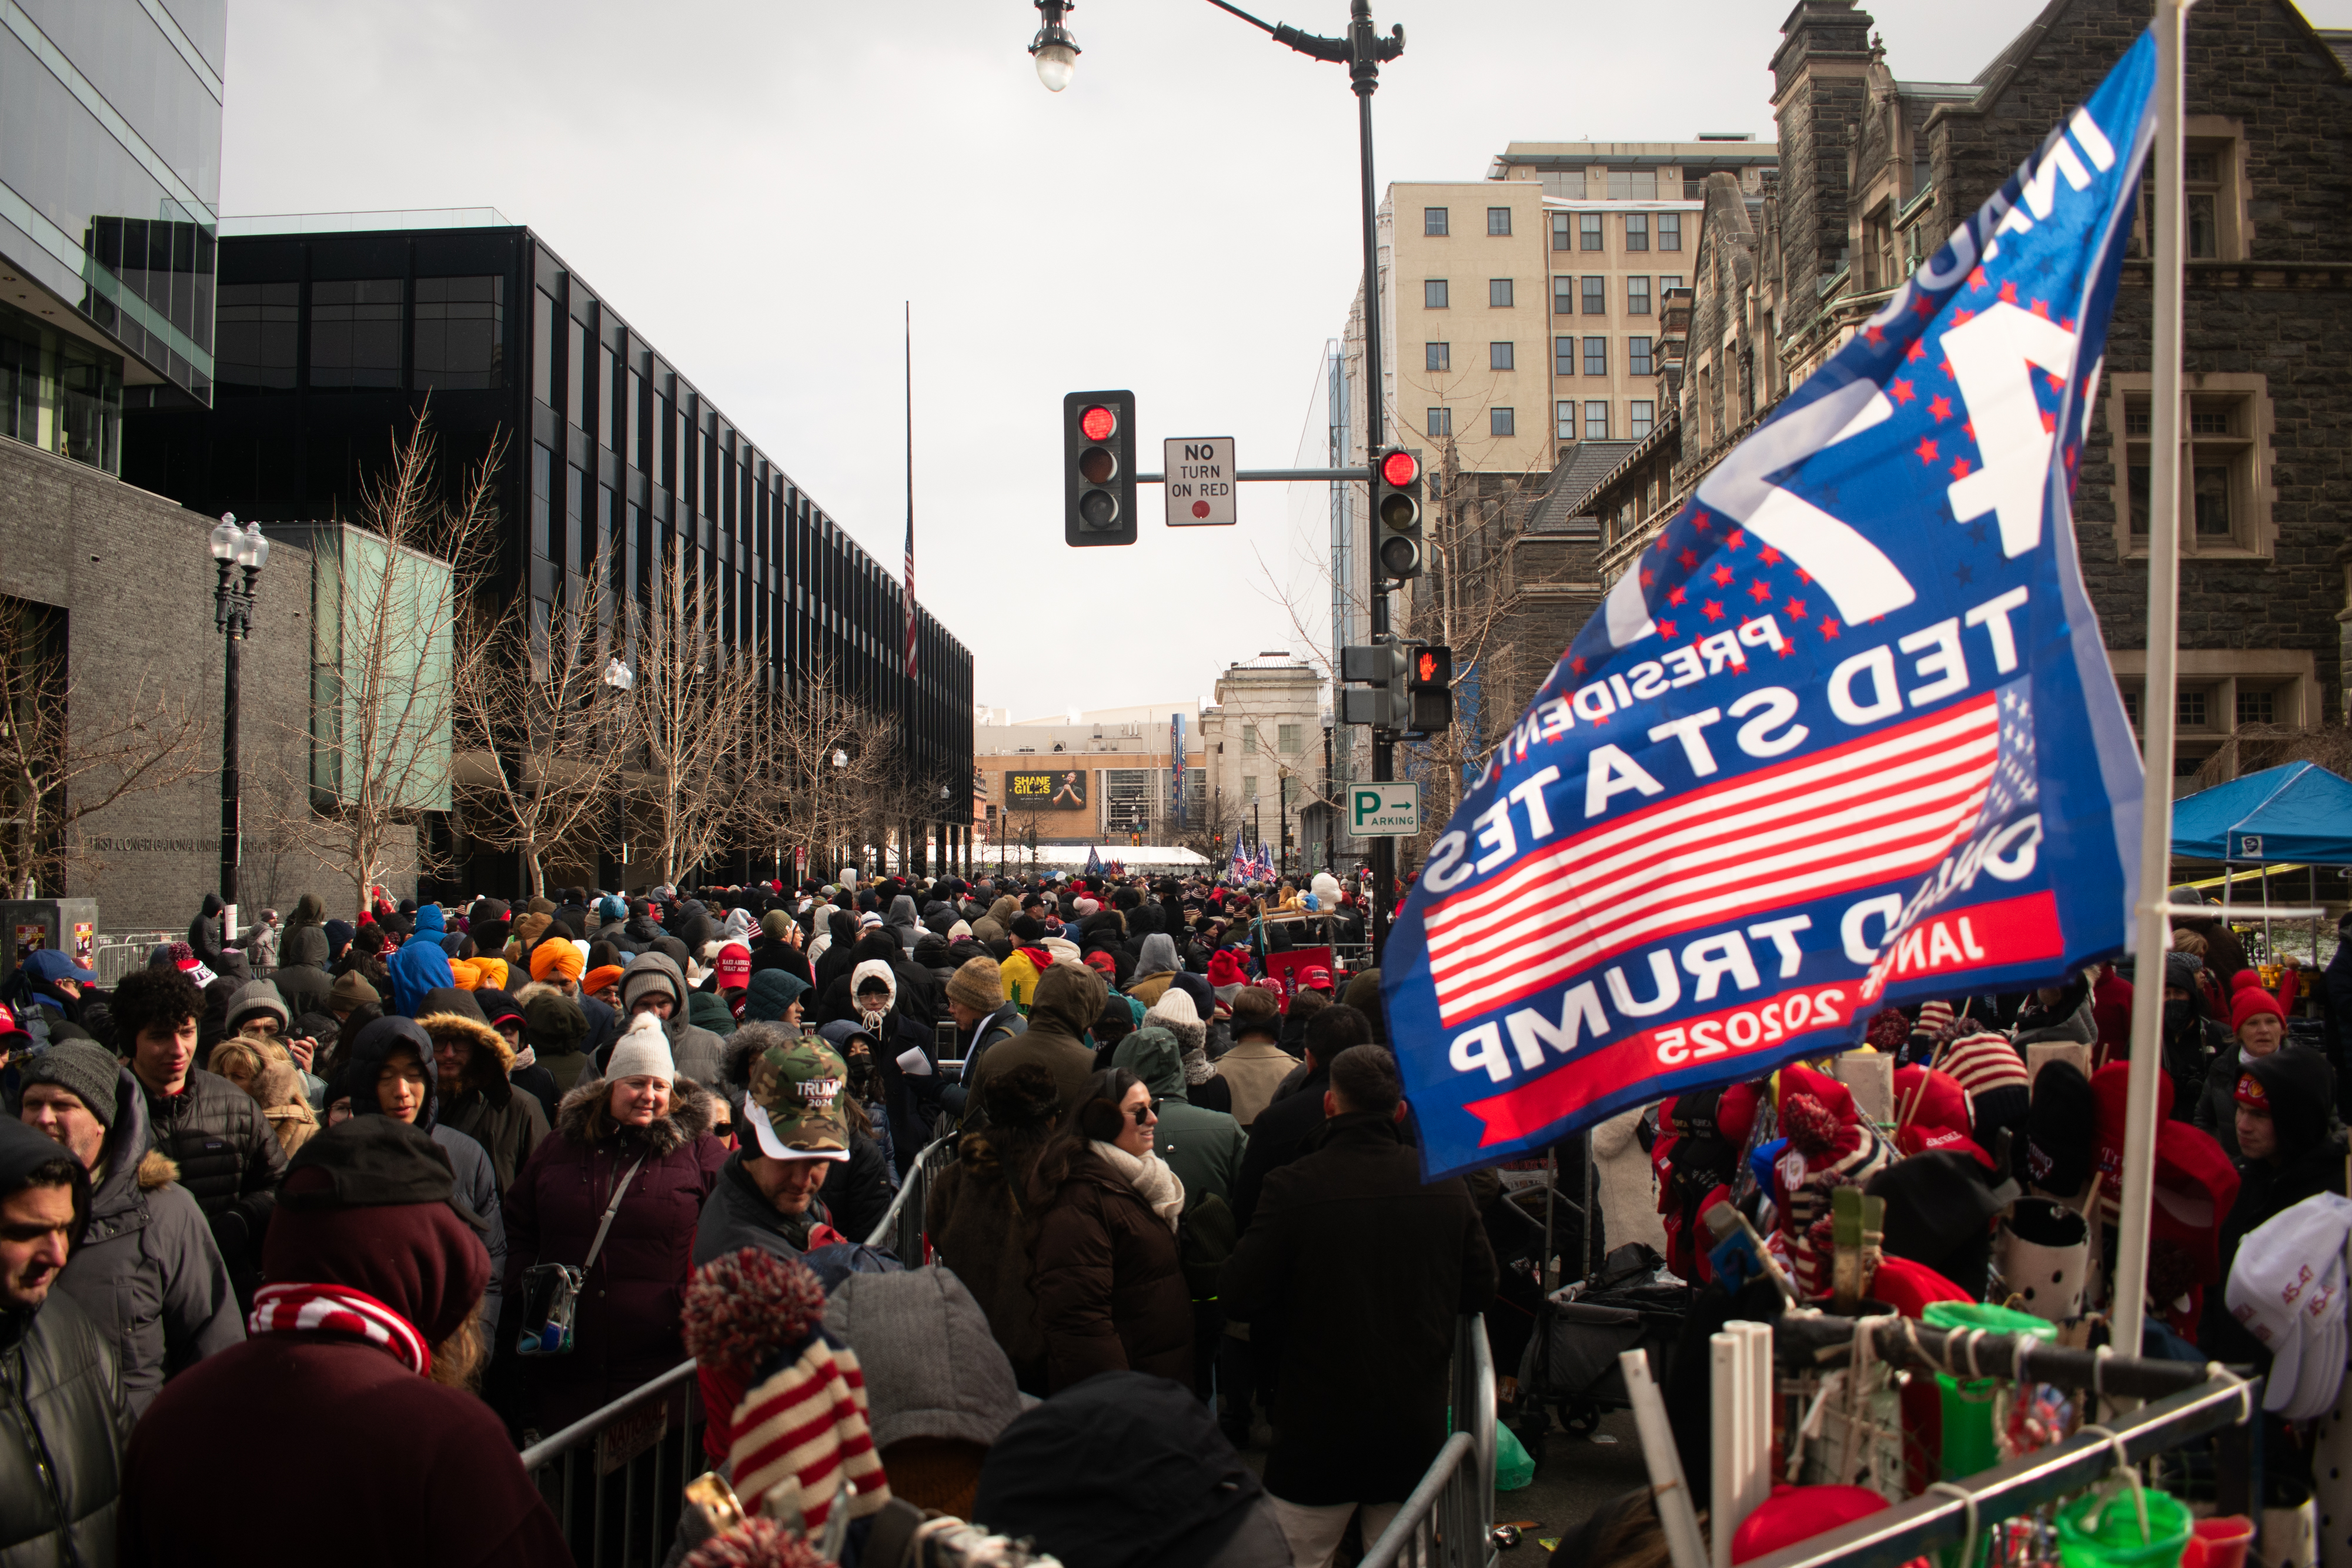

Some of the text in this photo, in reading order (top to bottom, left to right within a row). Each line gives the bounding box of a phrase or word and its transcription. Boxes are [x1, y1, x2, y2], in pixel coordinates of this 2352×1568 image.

[1185, 444, 1214, 461] NO
[1180, 464, 1220, 479] TURN
[1172, 483, 1228, 497] ON RED
[1014, 776, 1051, 785] SHANE
[91, 837, 112, 851] FIRST
[116, 837, 195, 851] CONGREGATIONAL
[796, 1080, 842, 1096] TRUMP
[608, 1399, 666, 1452] NATIONAL
